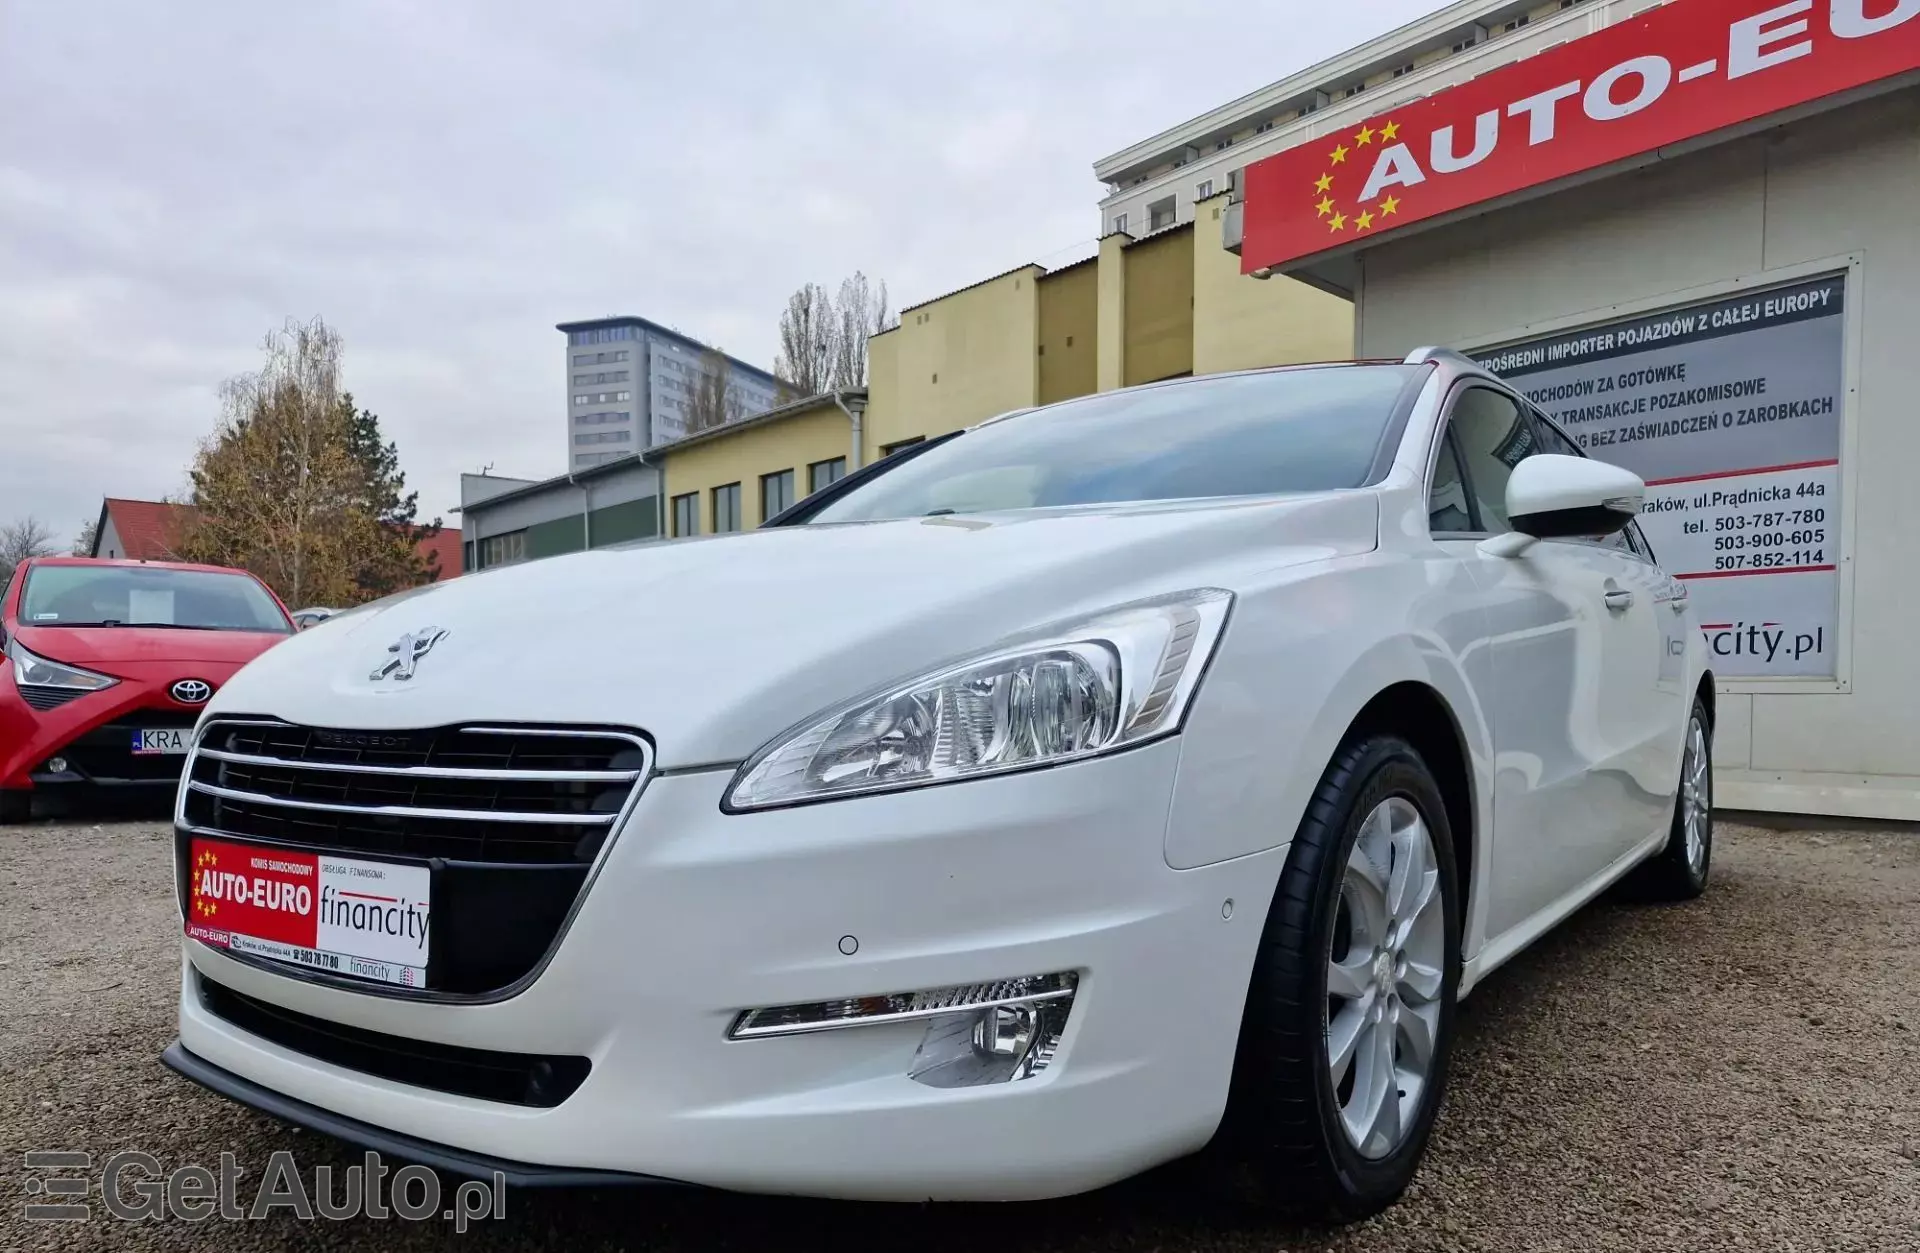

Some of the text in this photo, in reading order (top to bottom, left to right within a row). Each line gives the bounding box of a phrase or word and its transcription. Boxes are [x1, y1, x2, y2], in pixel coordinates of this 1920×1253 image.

[1548, 333, 1614, 361] IMPORTER
[1618, 315, 1695, 348] POJAZDÓW
[1698, 314, 1708, 331] Z
[1712, 302, 1760, 328] CAŁEJ
[1764, 288, 1831, 318] EUROPY
[1597, 376, 1614, 393] ZA
[1618, 363, 1686, 389] GOTÓWKĘ
[1562, 377, 1766, 425] TRANSAKCJE POZAKOMISOWE
[1591, 427, 1616, 447] BEZ
[1620, 410, 1718, 443] ZAŚWIADCZEŃ
[1722, 412, 1733, 428] O
[1737, 396, 1833, 426] ZAROBKACH
[1641, 481, 1825, 513] raków, ul.Prądnicka 44a
[1683, 508, 1825, 535] tel. 503-787-780
[1714, 529, 1825, 551] 503-900-605
[1715, 549, 1824, 570] 507-852-114
[1703, 622, 1823, 662] city.pl
[200, 869, 312, 916] AUTO-EURO
[321, 884, 430, 950] financity
[190, 926, 229, 944] AUTO-EURO
[350, 955, 391, 982] financity
